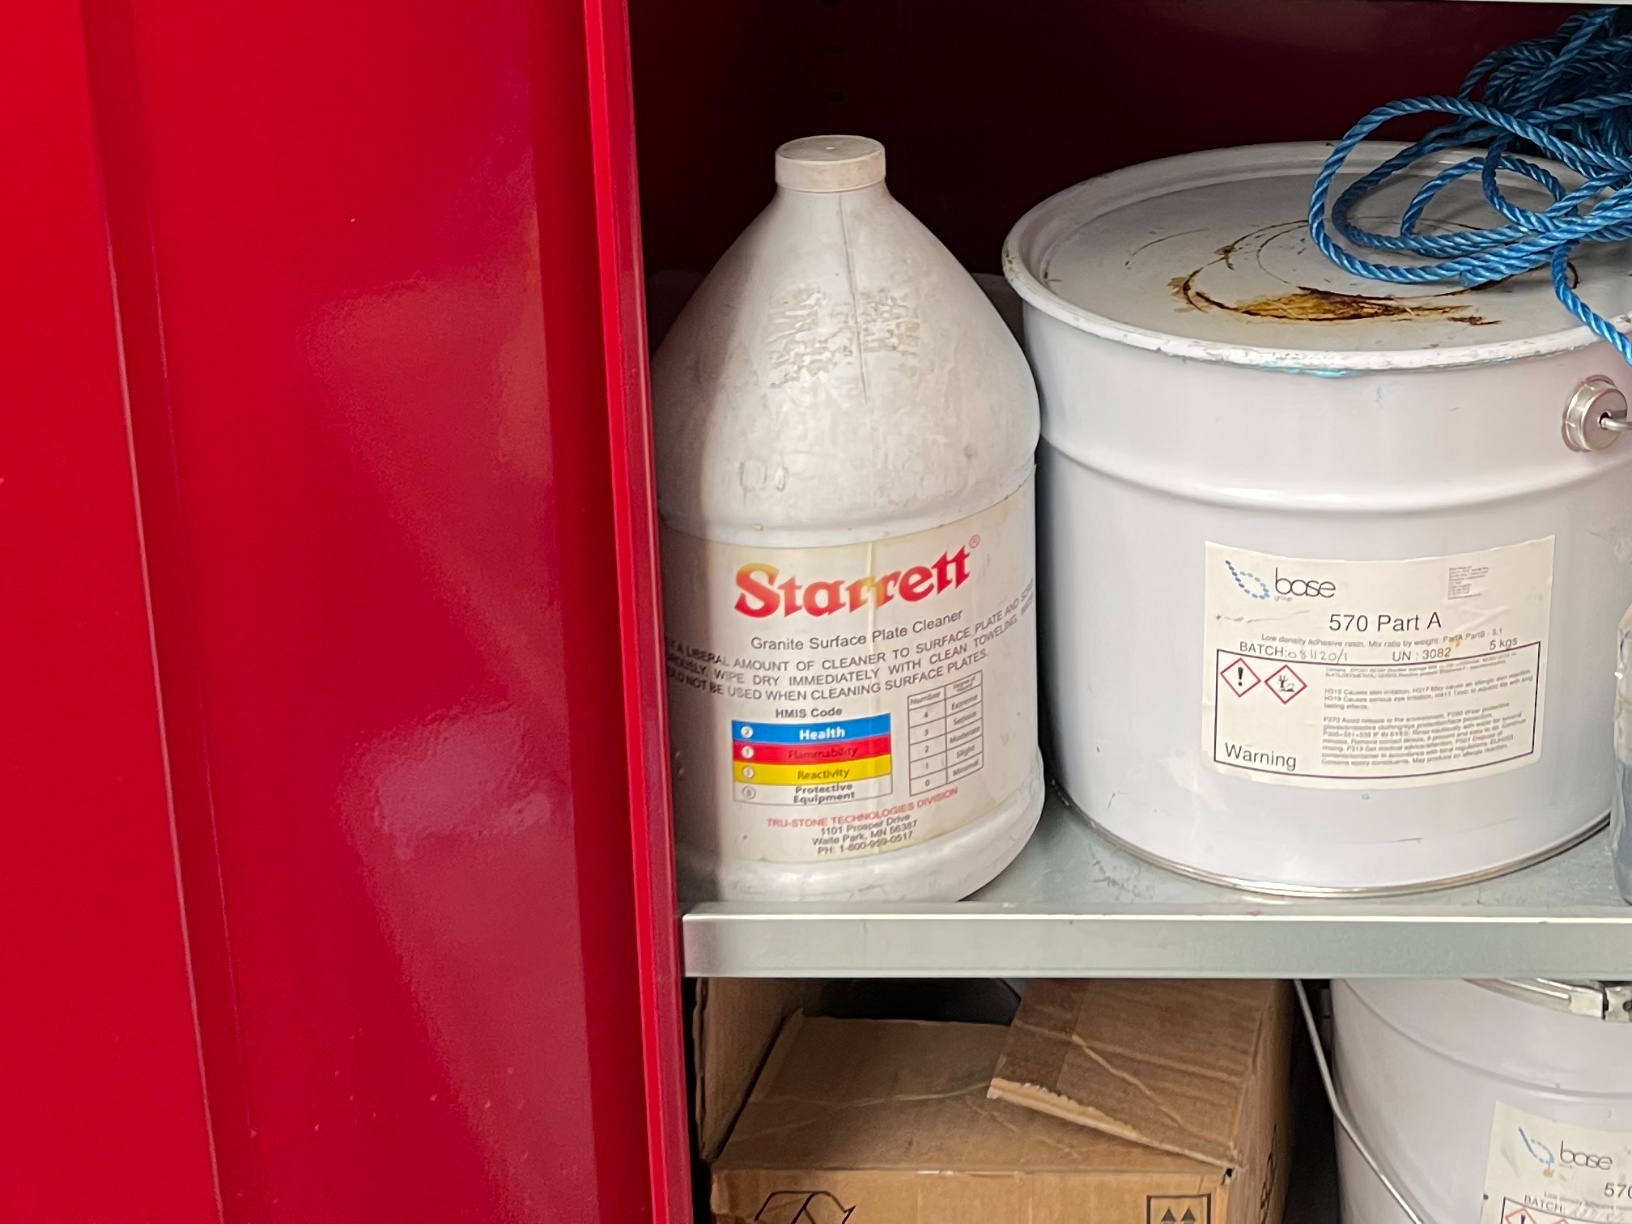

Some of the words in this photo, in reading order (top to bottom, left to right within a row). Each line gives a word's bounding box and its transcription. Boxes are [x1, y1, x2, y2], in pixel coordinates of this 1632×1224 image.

[1275, 567, 1337, 598] base
[750, 636, 804, 651] Granite
[809, 633, 867, 650] Surface
[871, 626, 908, 644] Plate
[912, 609, 964, 634] Cleaner
[1328, 613, 1369, 632] 570
[1377, 613, 1420, 633] Part
[1426, 611, 1442, 630] A
[733, 657, 790, 672] AMOUNT
[795, 659, 815, 671] OF
[821, 651, 886, 671] CLEANER
[891, 646, 910, 660] TO
[915, 626, 971, 655] SURFACE
[974, 610, 1004, 635] PLATE
[752, 674, 780, 687] DRY
[788, 667, 880, 687] IMMEDIATELY
[887, 658, 922, 676] WITH
[929, 643, 968, 666] CLEAN
[973, 613, 1018, 648] TOWELING
[1308, 637, 1343, 647] adhesive
[1392, 650, 1412, 662] UN
[1421, 647, 1452, 661] 3082
[1489, 640, 1496, 651] 5
[1499, 636, 1518, 651] kgs
[727, 686, 762, 701] USED
[765, 688, 807, 702] WHEN
[810, 681, 882, 701] CLEANING
[884, 665, 945, 691] SURFACE
[775, 707, 807, 719] HMIS
[811, 706, 843, 718] Code
[799, 726, 846, 741] Health
[1225, 741, 1297, 772] Warning
[796, 767, 851, 781] Reactivity
[793, 790, 855, 805] Equipment
[795, 783, 853, 795] Protective
[767, 816, 828, 827] TRU-STONE
[830, 802, 915, 824] TECHNOLOGIES
[916, 786, 959, 808] DIVISION
[820, 827, 843, 836] 1101
[1559, 1139, 1613, 1171] base
